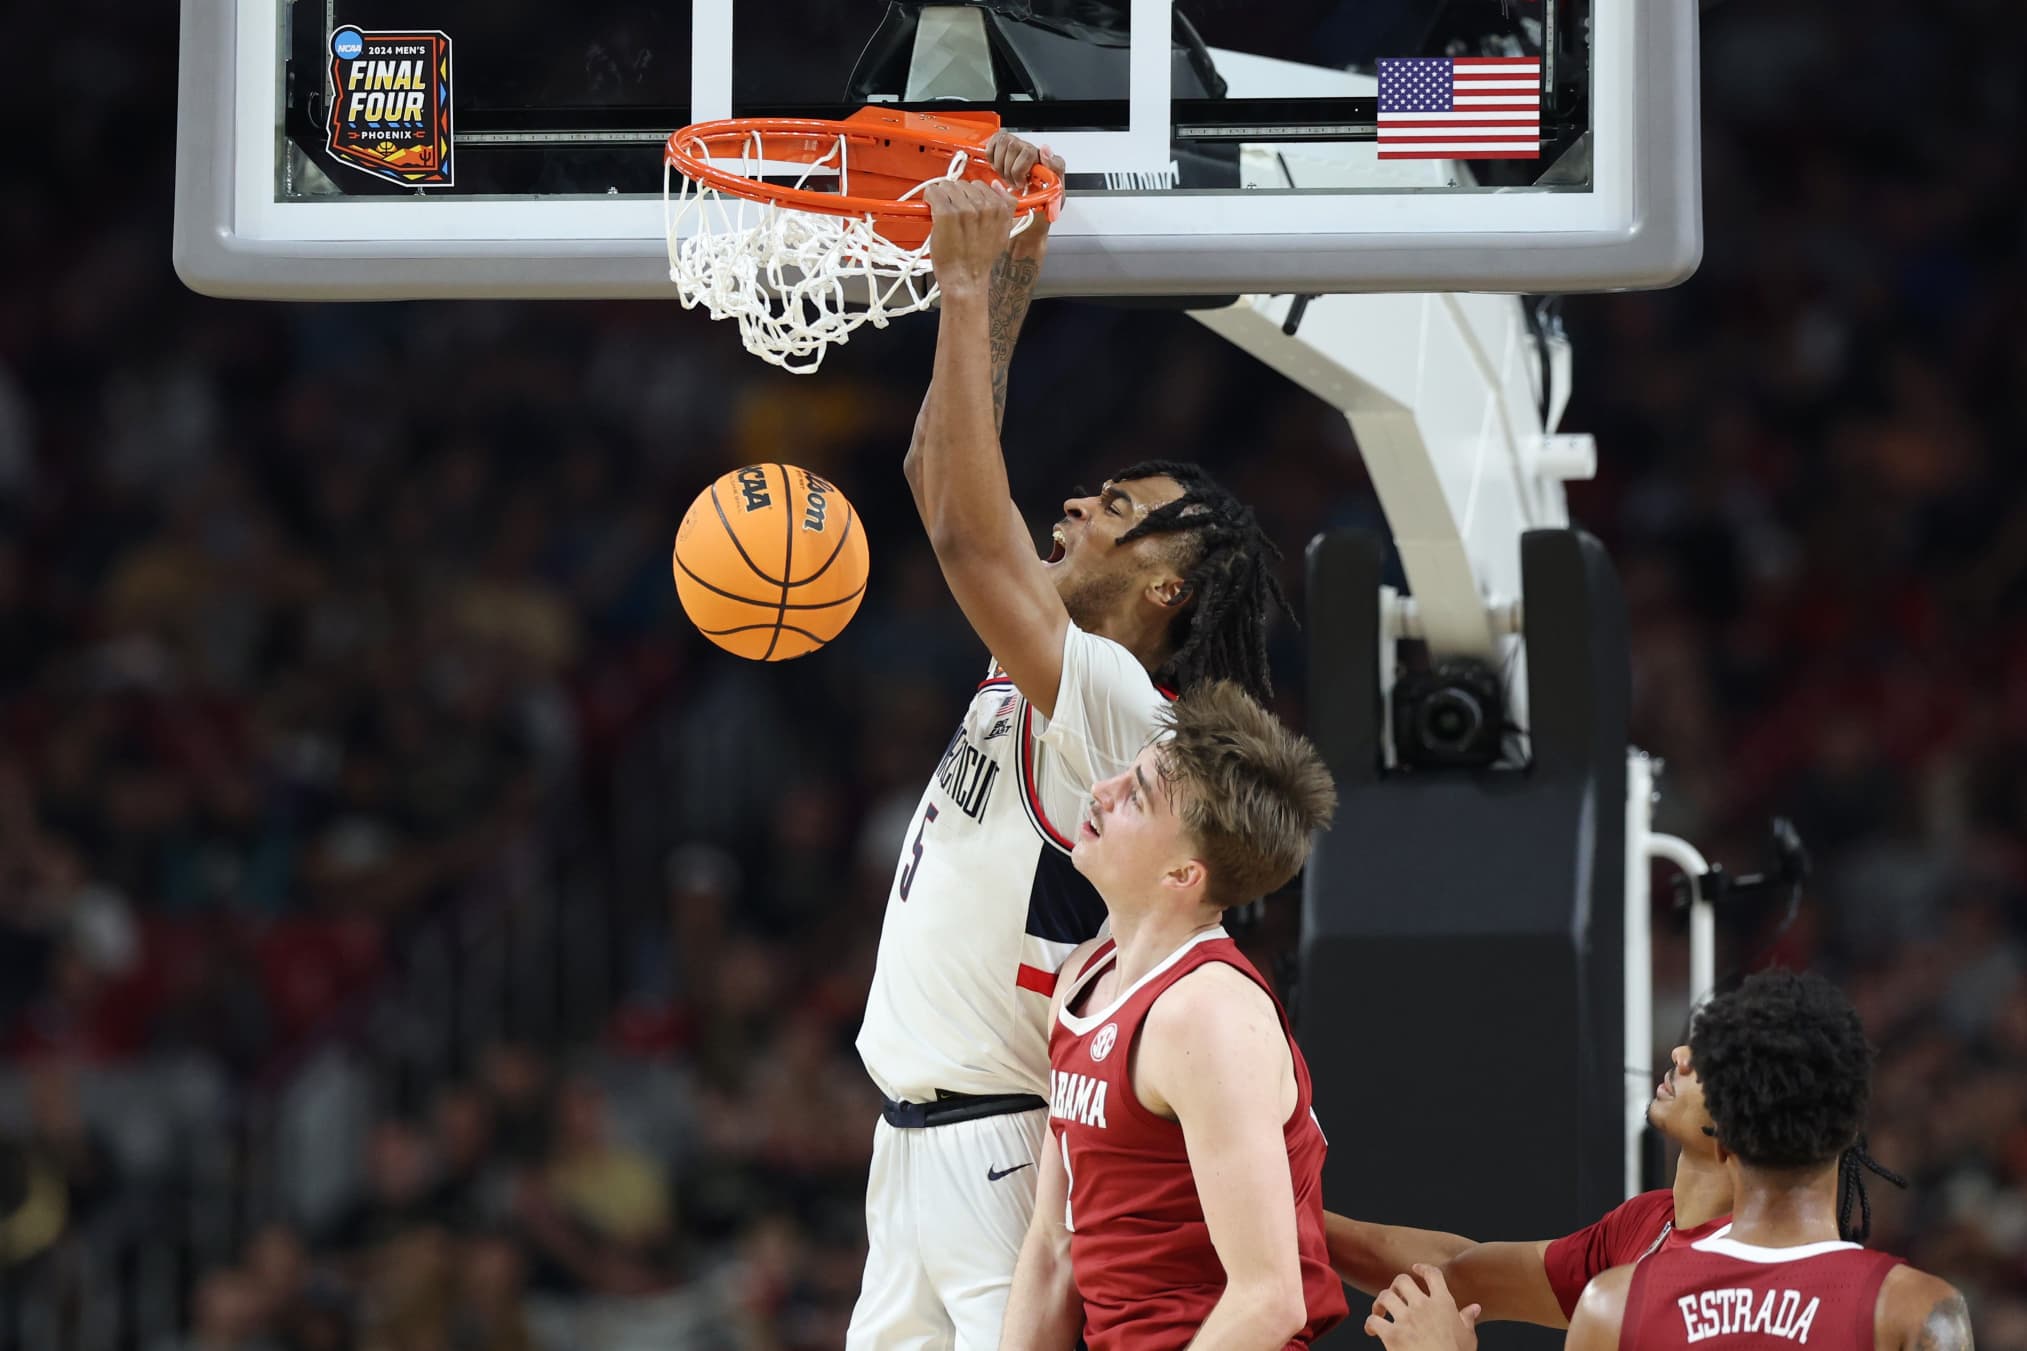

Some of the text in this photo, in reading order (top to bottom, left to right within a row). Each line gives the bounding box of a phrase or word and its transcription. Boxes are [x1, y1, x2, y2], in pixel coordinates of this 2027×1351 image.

[368, 46, 426, 55] 2024 MEN'S
[348, 60, 426, 91] FINAL
[348, 91, 425, 122] FOUR
[361, 131, 412, 139] PHOENIX
[803, 471, 835, 532] lson
[900, 802, 939, 902] 5
[1050, 1069, 1108, 1128] BAMA
[1678, 1288, 1820, 1344] ESTRADA
